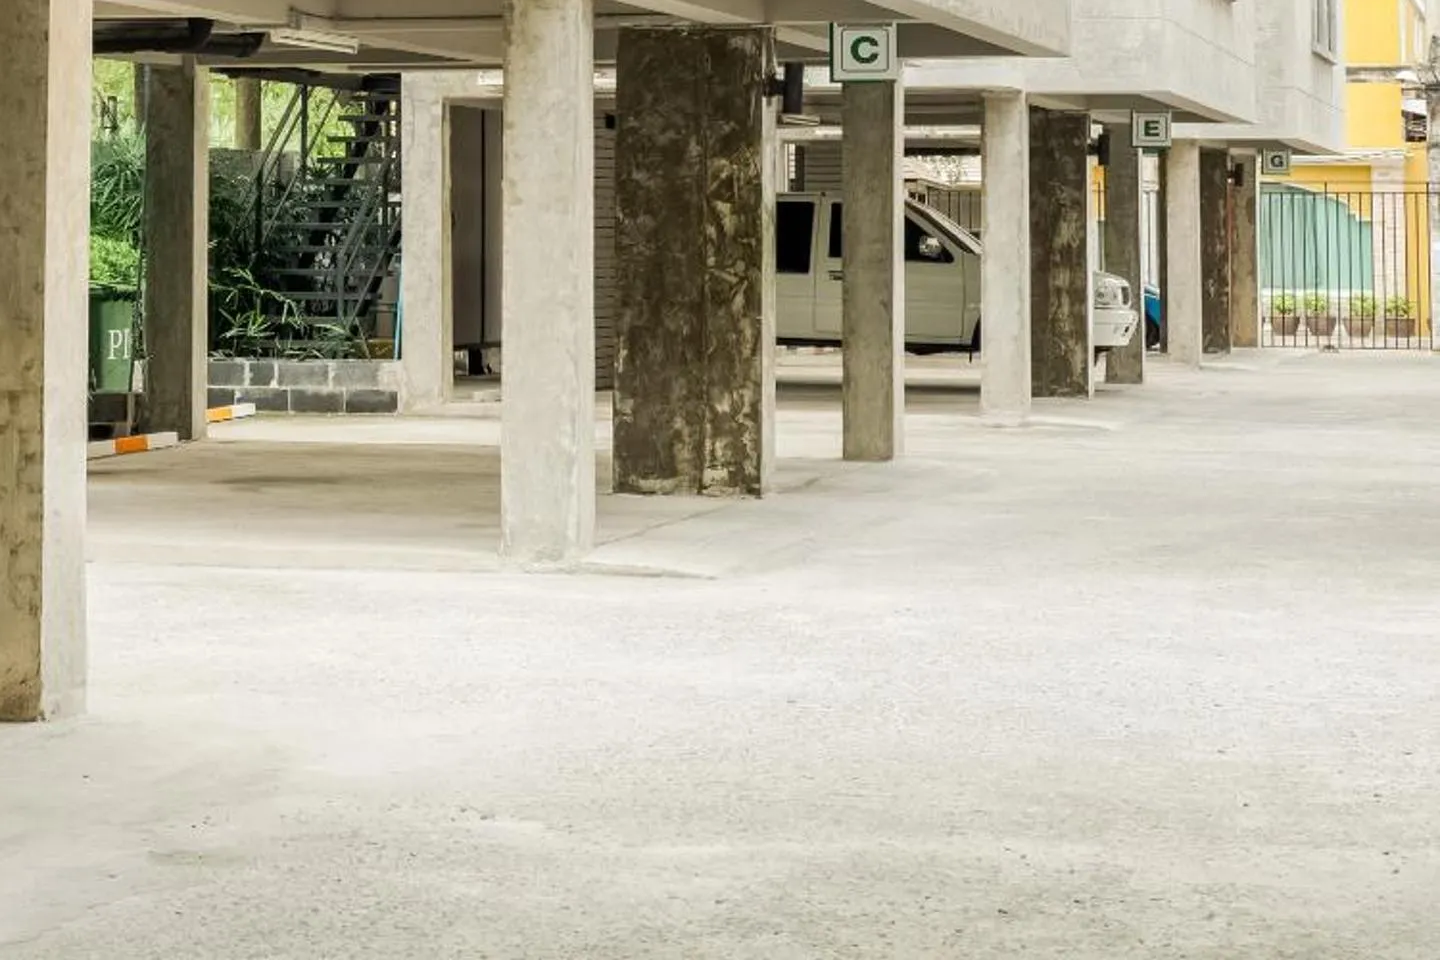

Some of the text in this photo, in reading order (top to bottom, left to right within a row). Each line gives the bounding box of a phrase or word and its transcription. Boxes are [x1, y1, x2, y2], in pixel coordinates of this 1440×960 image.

[850, 36, 879, 64] C
[1144, 120, 1160, 137] E
[1270, 155, 1284, 168] G
